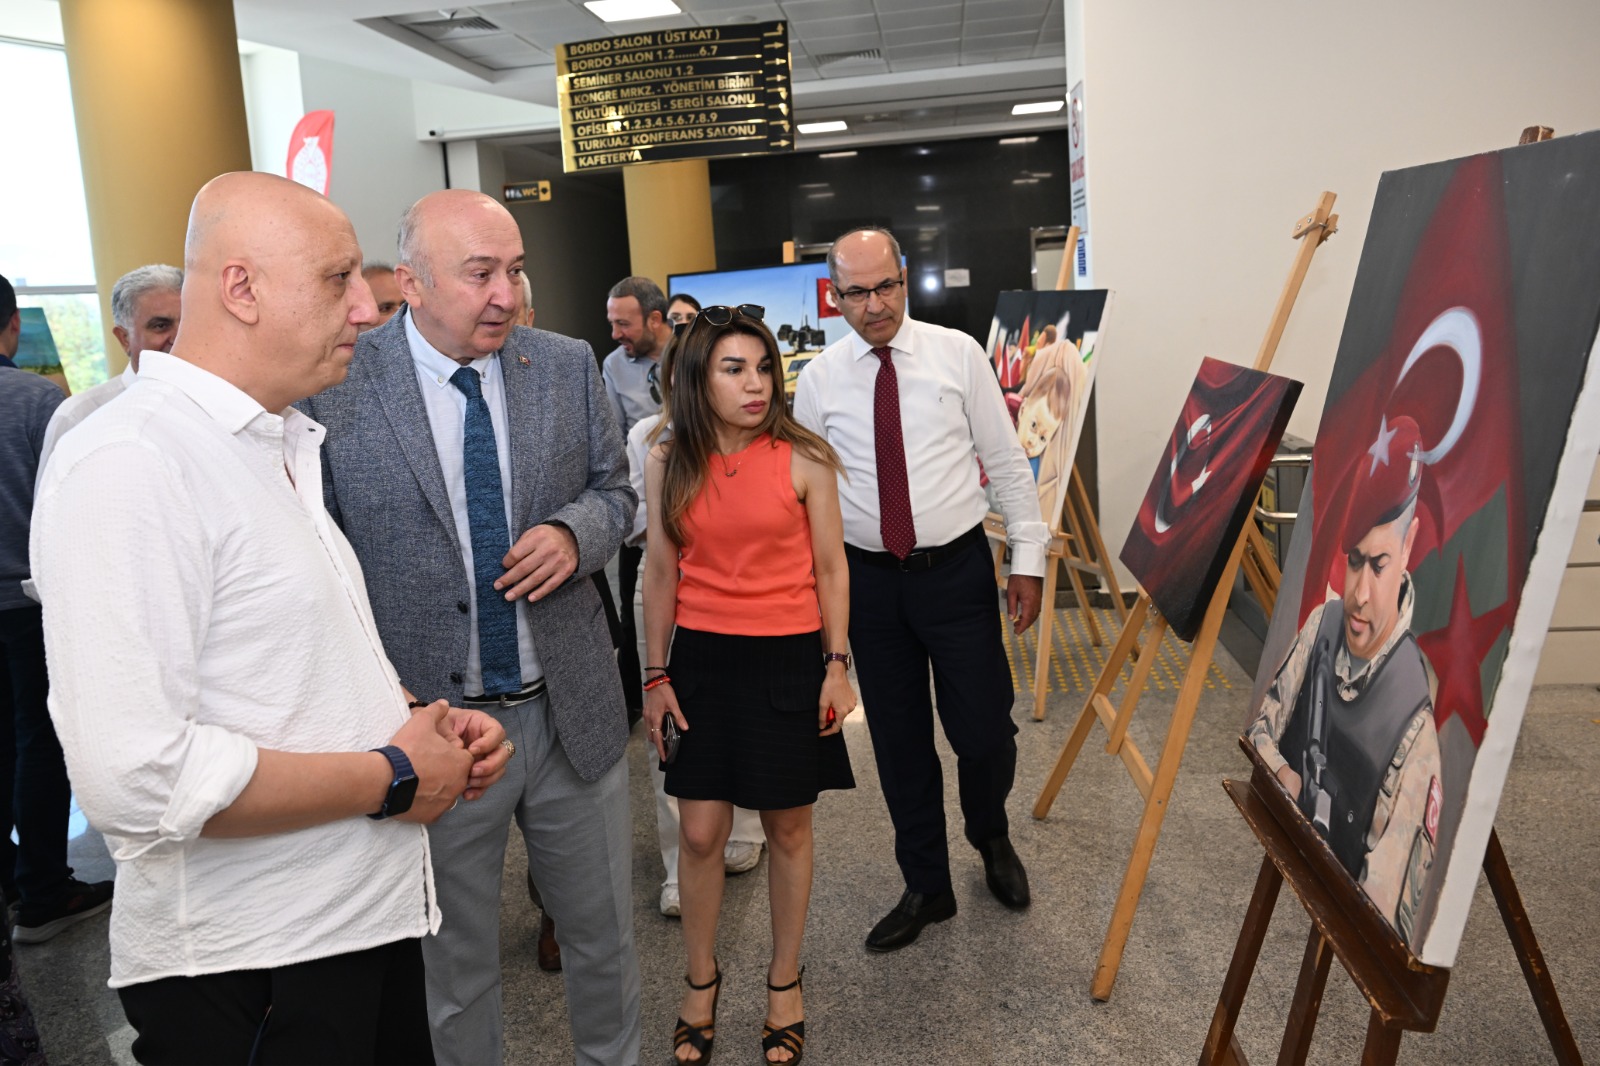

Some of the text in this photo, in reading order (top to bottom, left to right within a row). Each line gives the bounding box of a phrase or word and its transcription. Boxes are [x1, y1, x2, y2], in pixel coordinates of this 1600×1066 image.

[570, 40, 611, 55] BORDO
[613, 34, 652, 49] SALON
[664, 29, 687, 43] ÜST
[689, 28, 713, 41] KAT
[571, 57, 612, 71] BORDO
[614, 50, 653, 65] SALON
[573, 65, 694, 89] SEMİNER SALONU 1.2
[574, 88, 619, 105] KONGRE
[663, 77, 715, 93] YÖNETİM
[718, 74, 754, 89] BİRİMİ
[617, 99, 661, 115] MÜZESİ
[670, 96, 704, 110] SERGİ
[707, 93, 756, 107] SALONU
[577, 120, 622, 137] OFİSLER
[578, 125, 757, 151] TURKUAZ KONFERANS SALONU
[579, 149, 643, 167] KAFETERYA
[521, 187, 538, 196] WC
